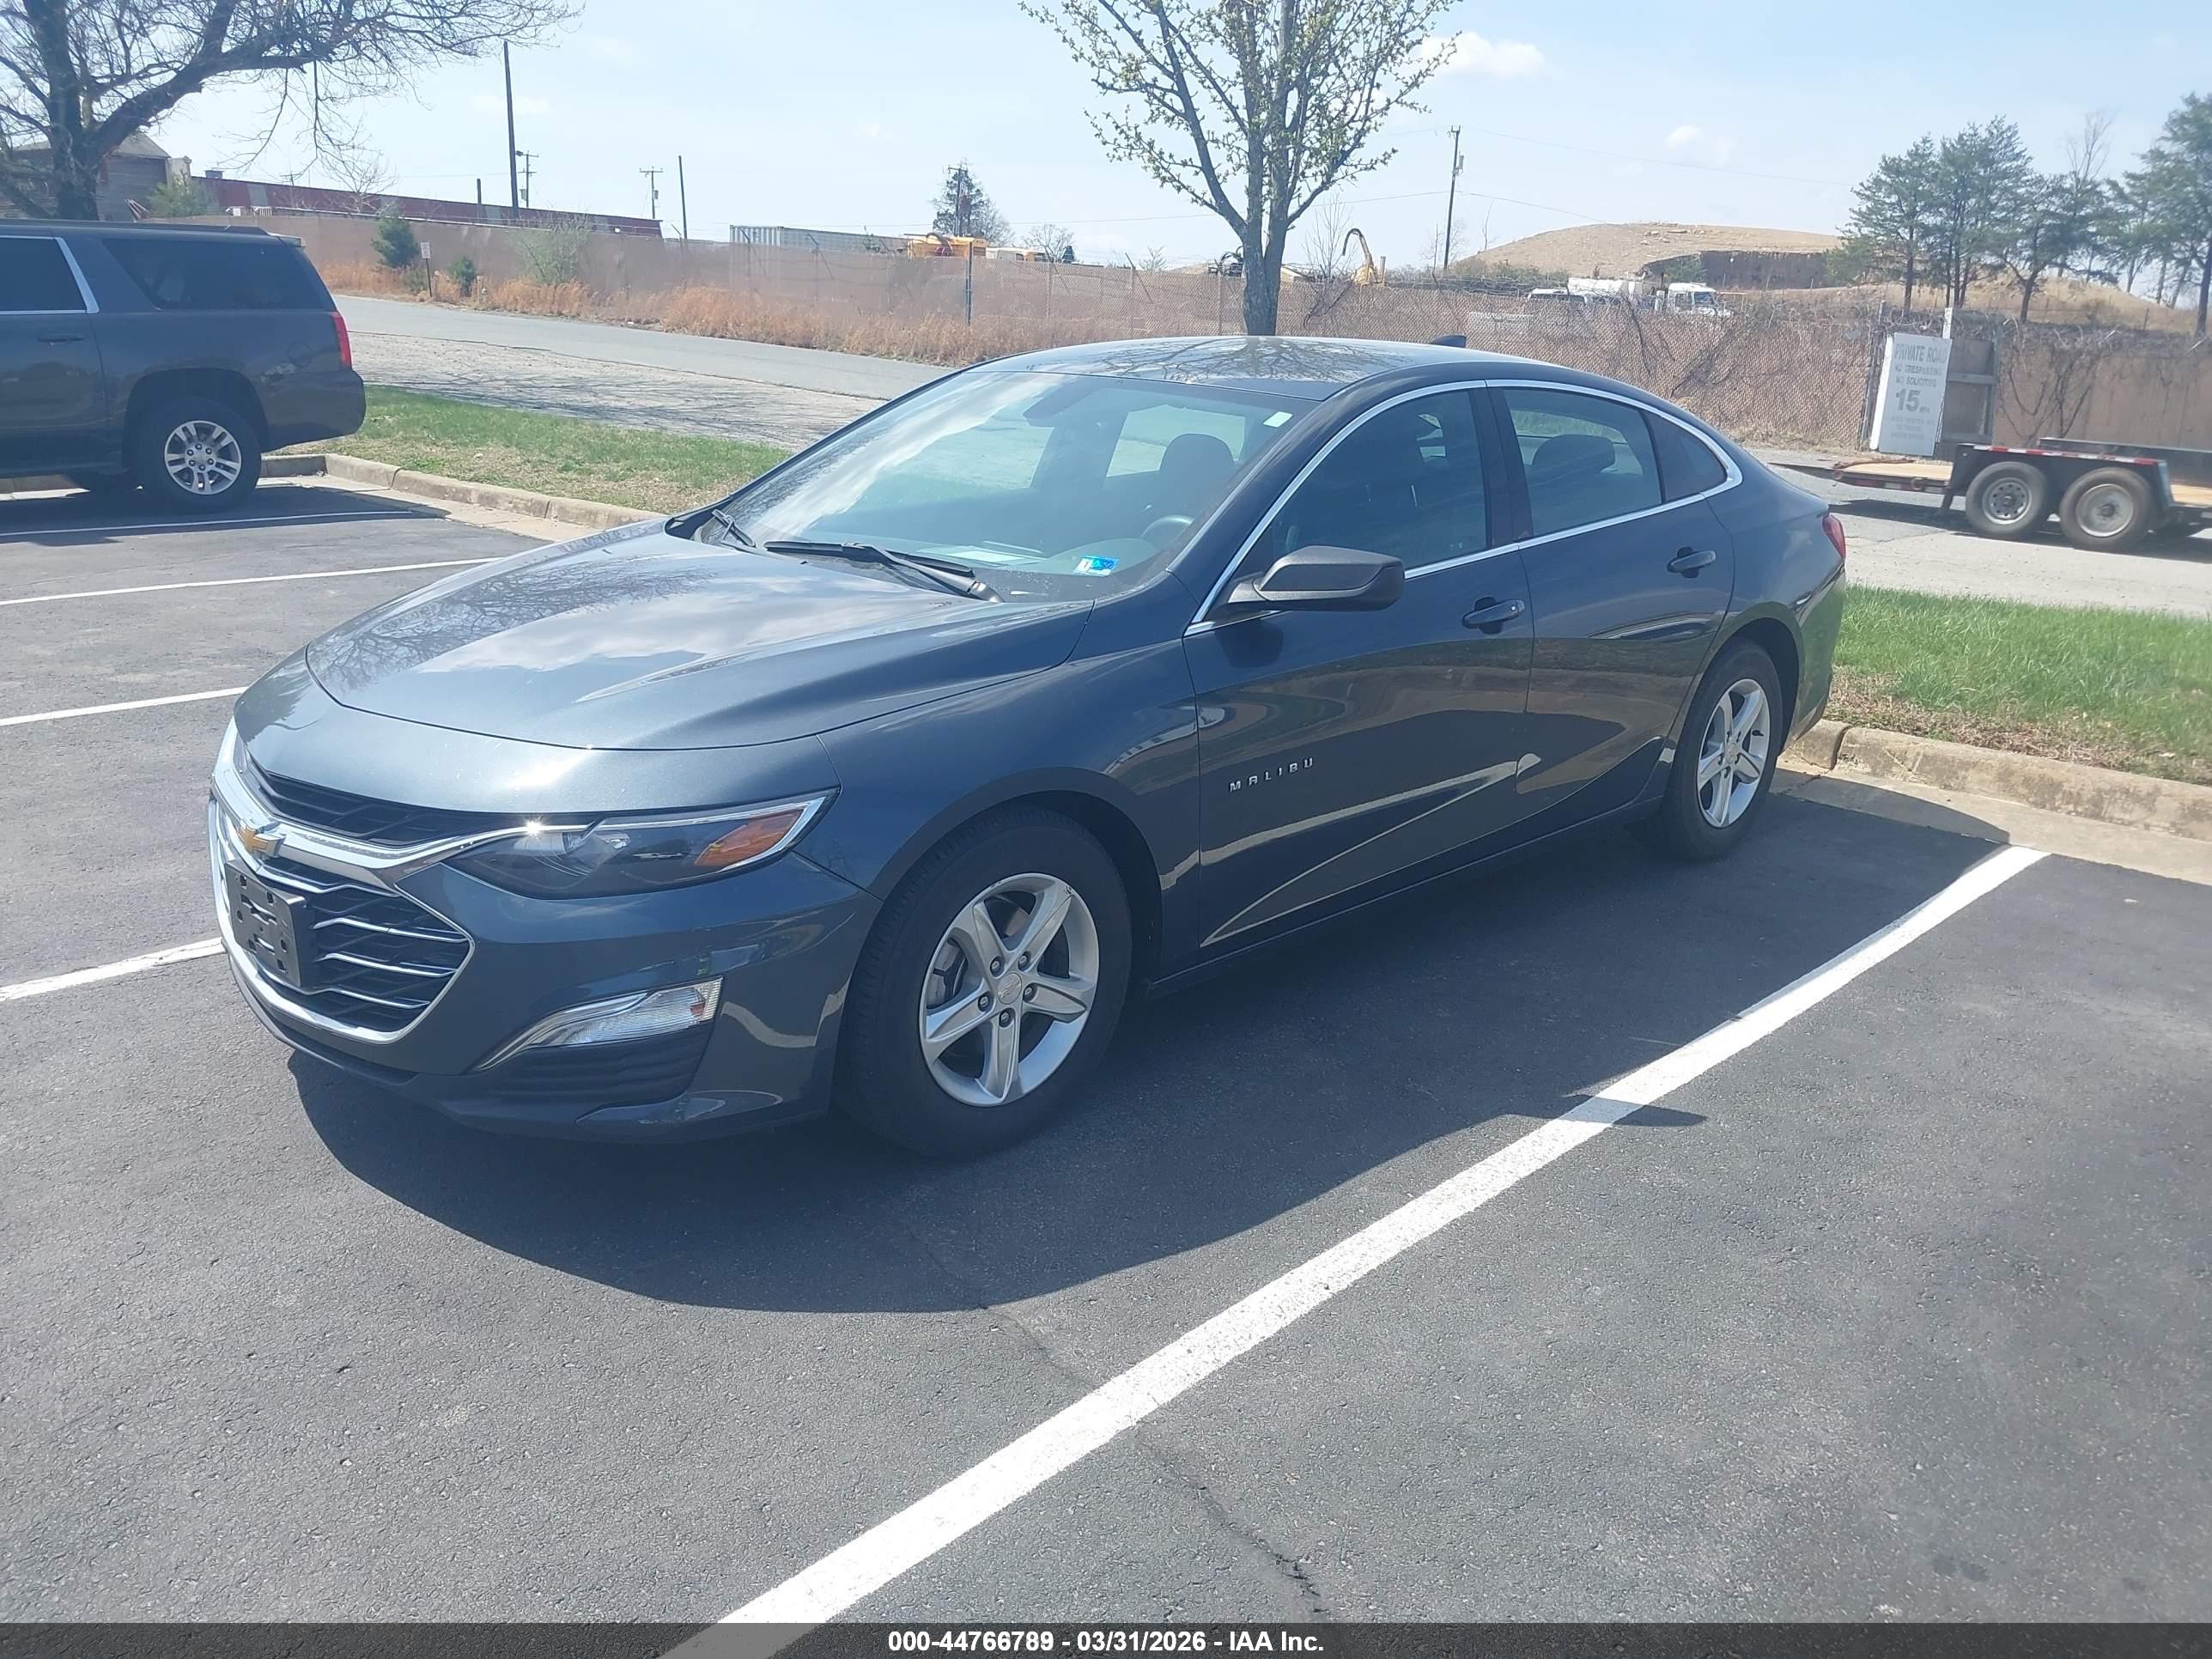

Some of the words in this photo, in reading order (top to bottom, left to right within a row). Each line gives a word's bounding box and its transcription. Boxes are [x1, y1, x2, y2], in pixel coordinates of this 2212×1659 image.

[1894, 343, 1925, 362] PRIVATE
[1896, 389, 1920, 412] 15
[1230, 757, 1313, 793] MALIBU
